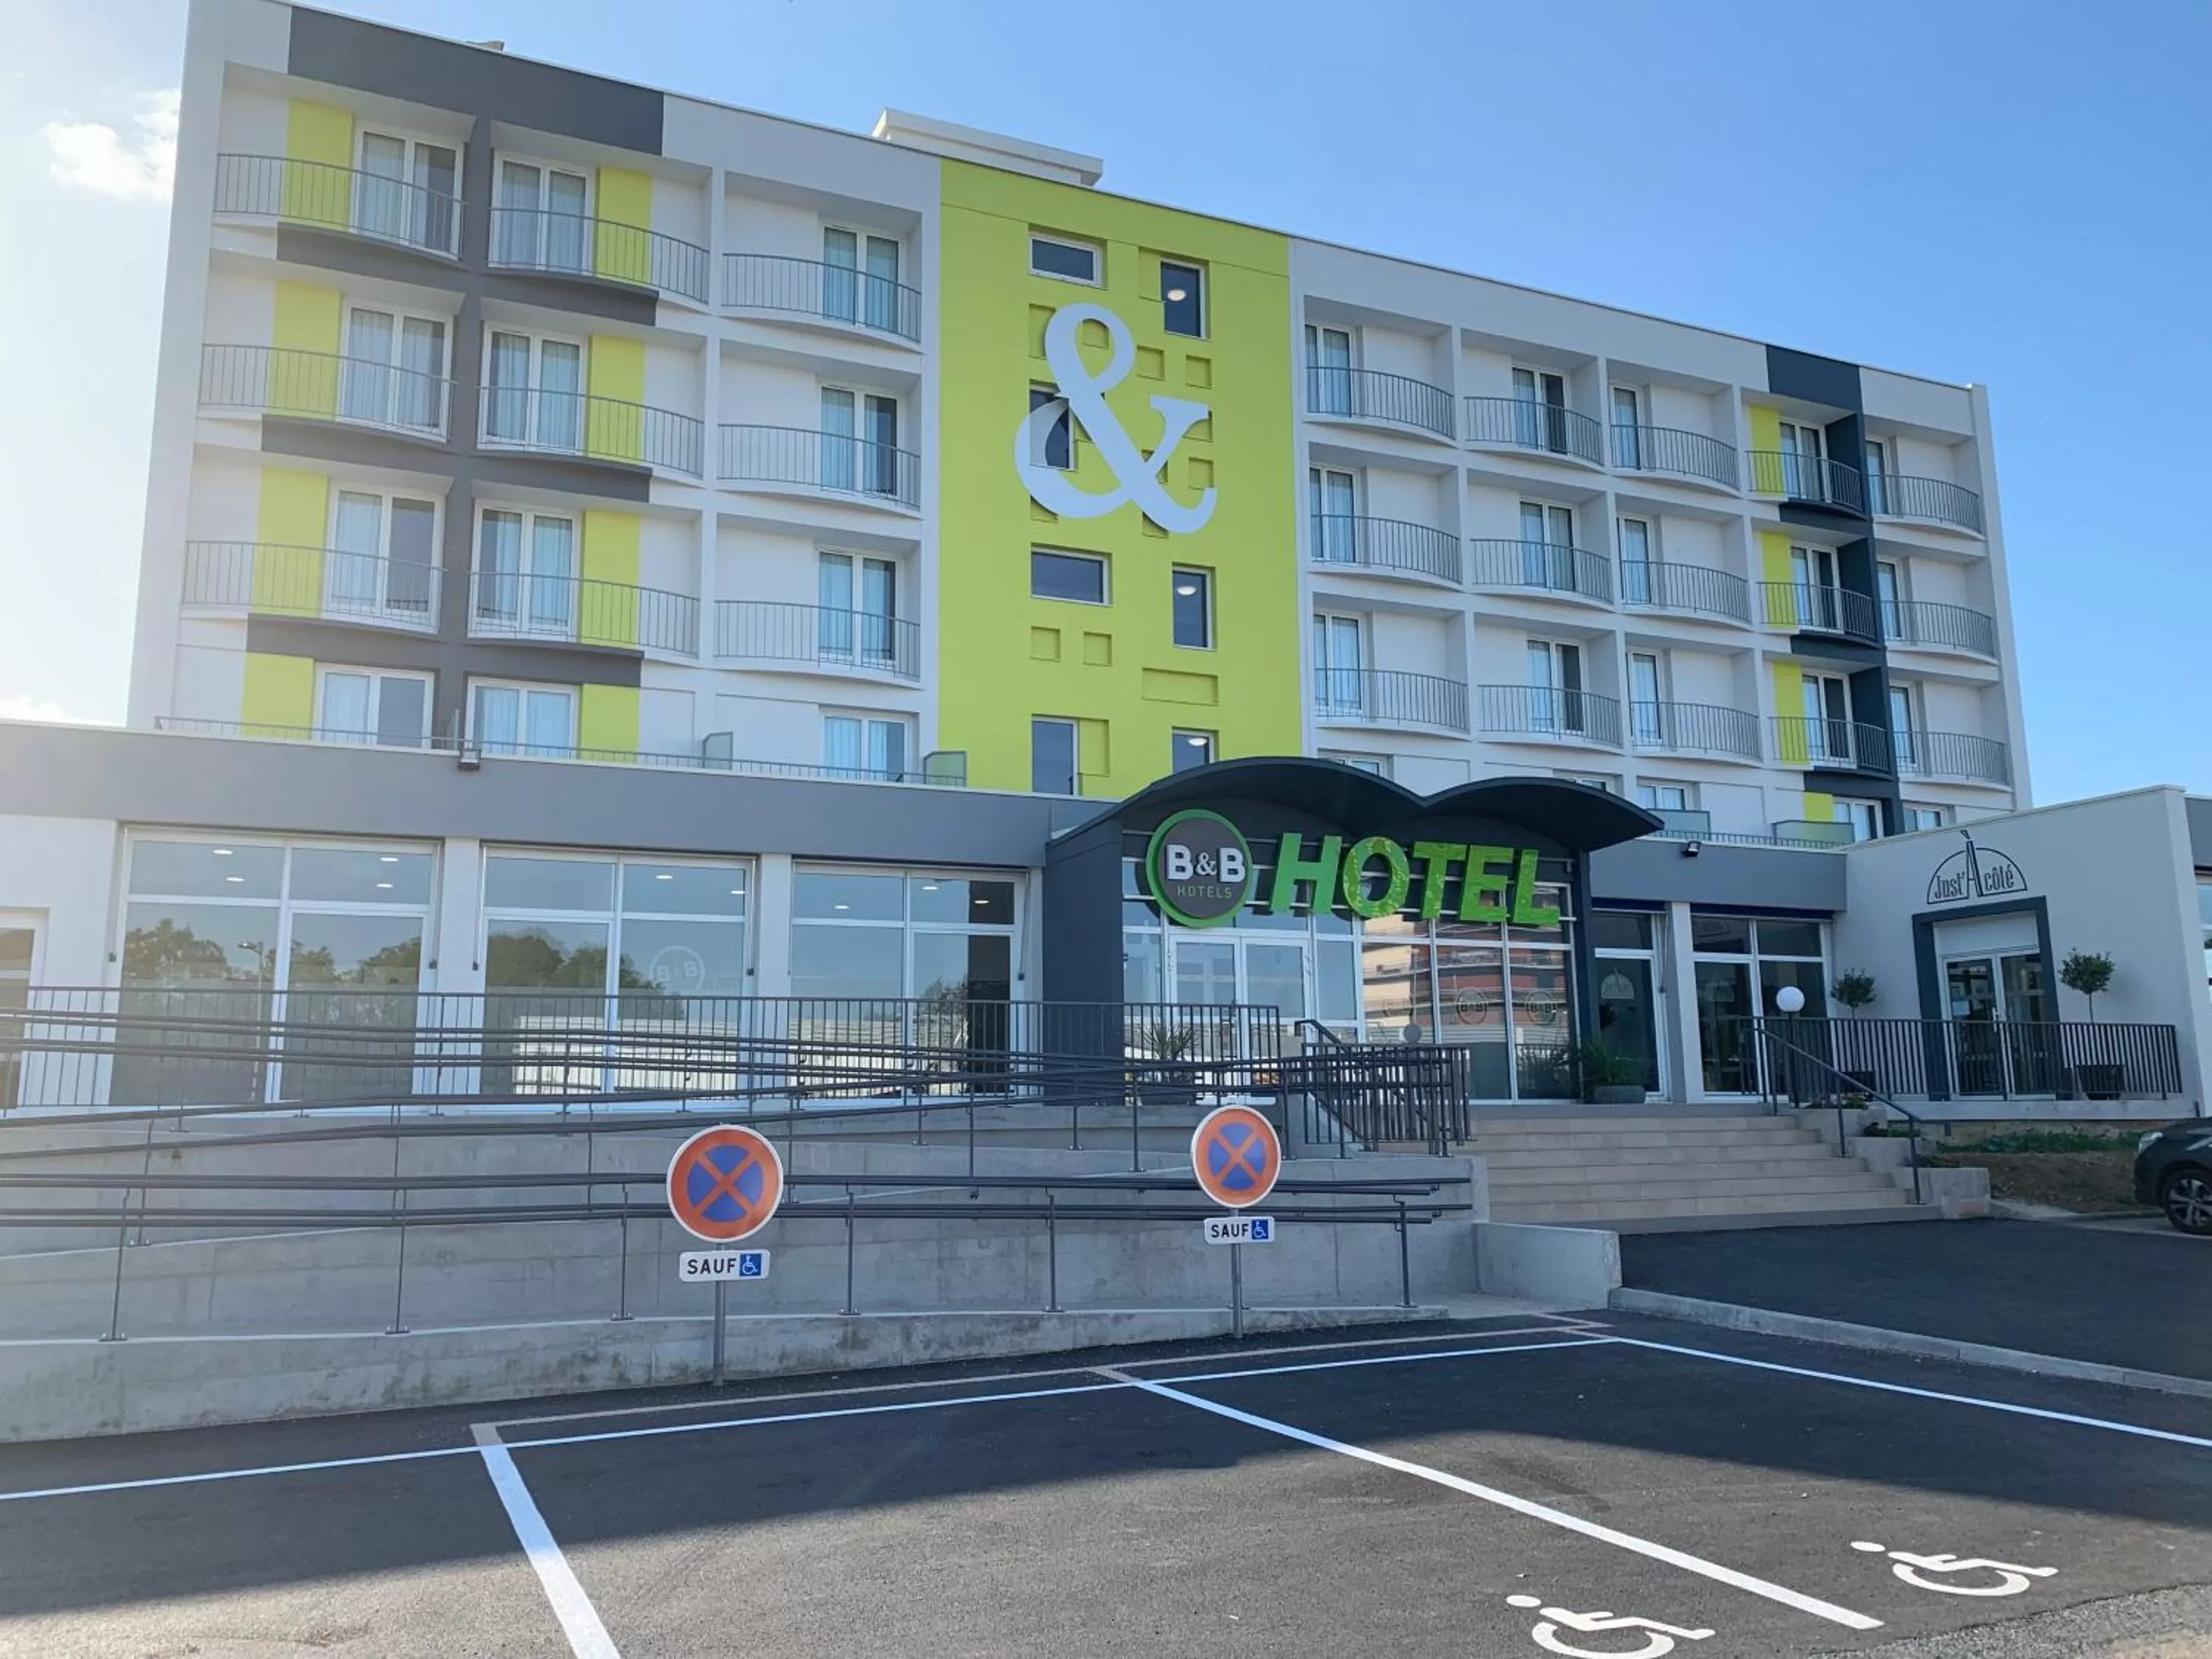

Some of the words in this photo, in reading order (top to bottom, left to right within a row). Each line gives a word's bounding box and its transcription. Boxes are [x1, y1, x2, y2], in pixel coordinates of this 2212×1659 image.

[1014, 302, 1218, 535] &
[1166, 844, 1245, 883] B&B
[1984, 863, 2014, 891] côté
[1177, 884, 1232, 899] HOTELS
[1270, 831, 1560, 925] HOTEL
[1211, 1223, 1249, 1238] SAUF
[686, 1258, 737, 1275] SAUF
